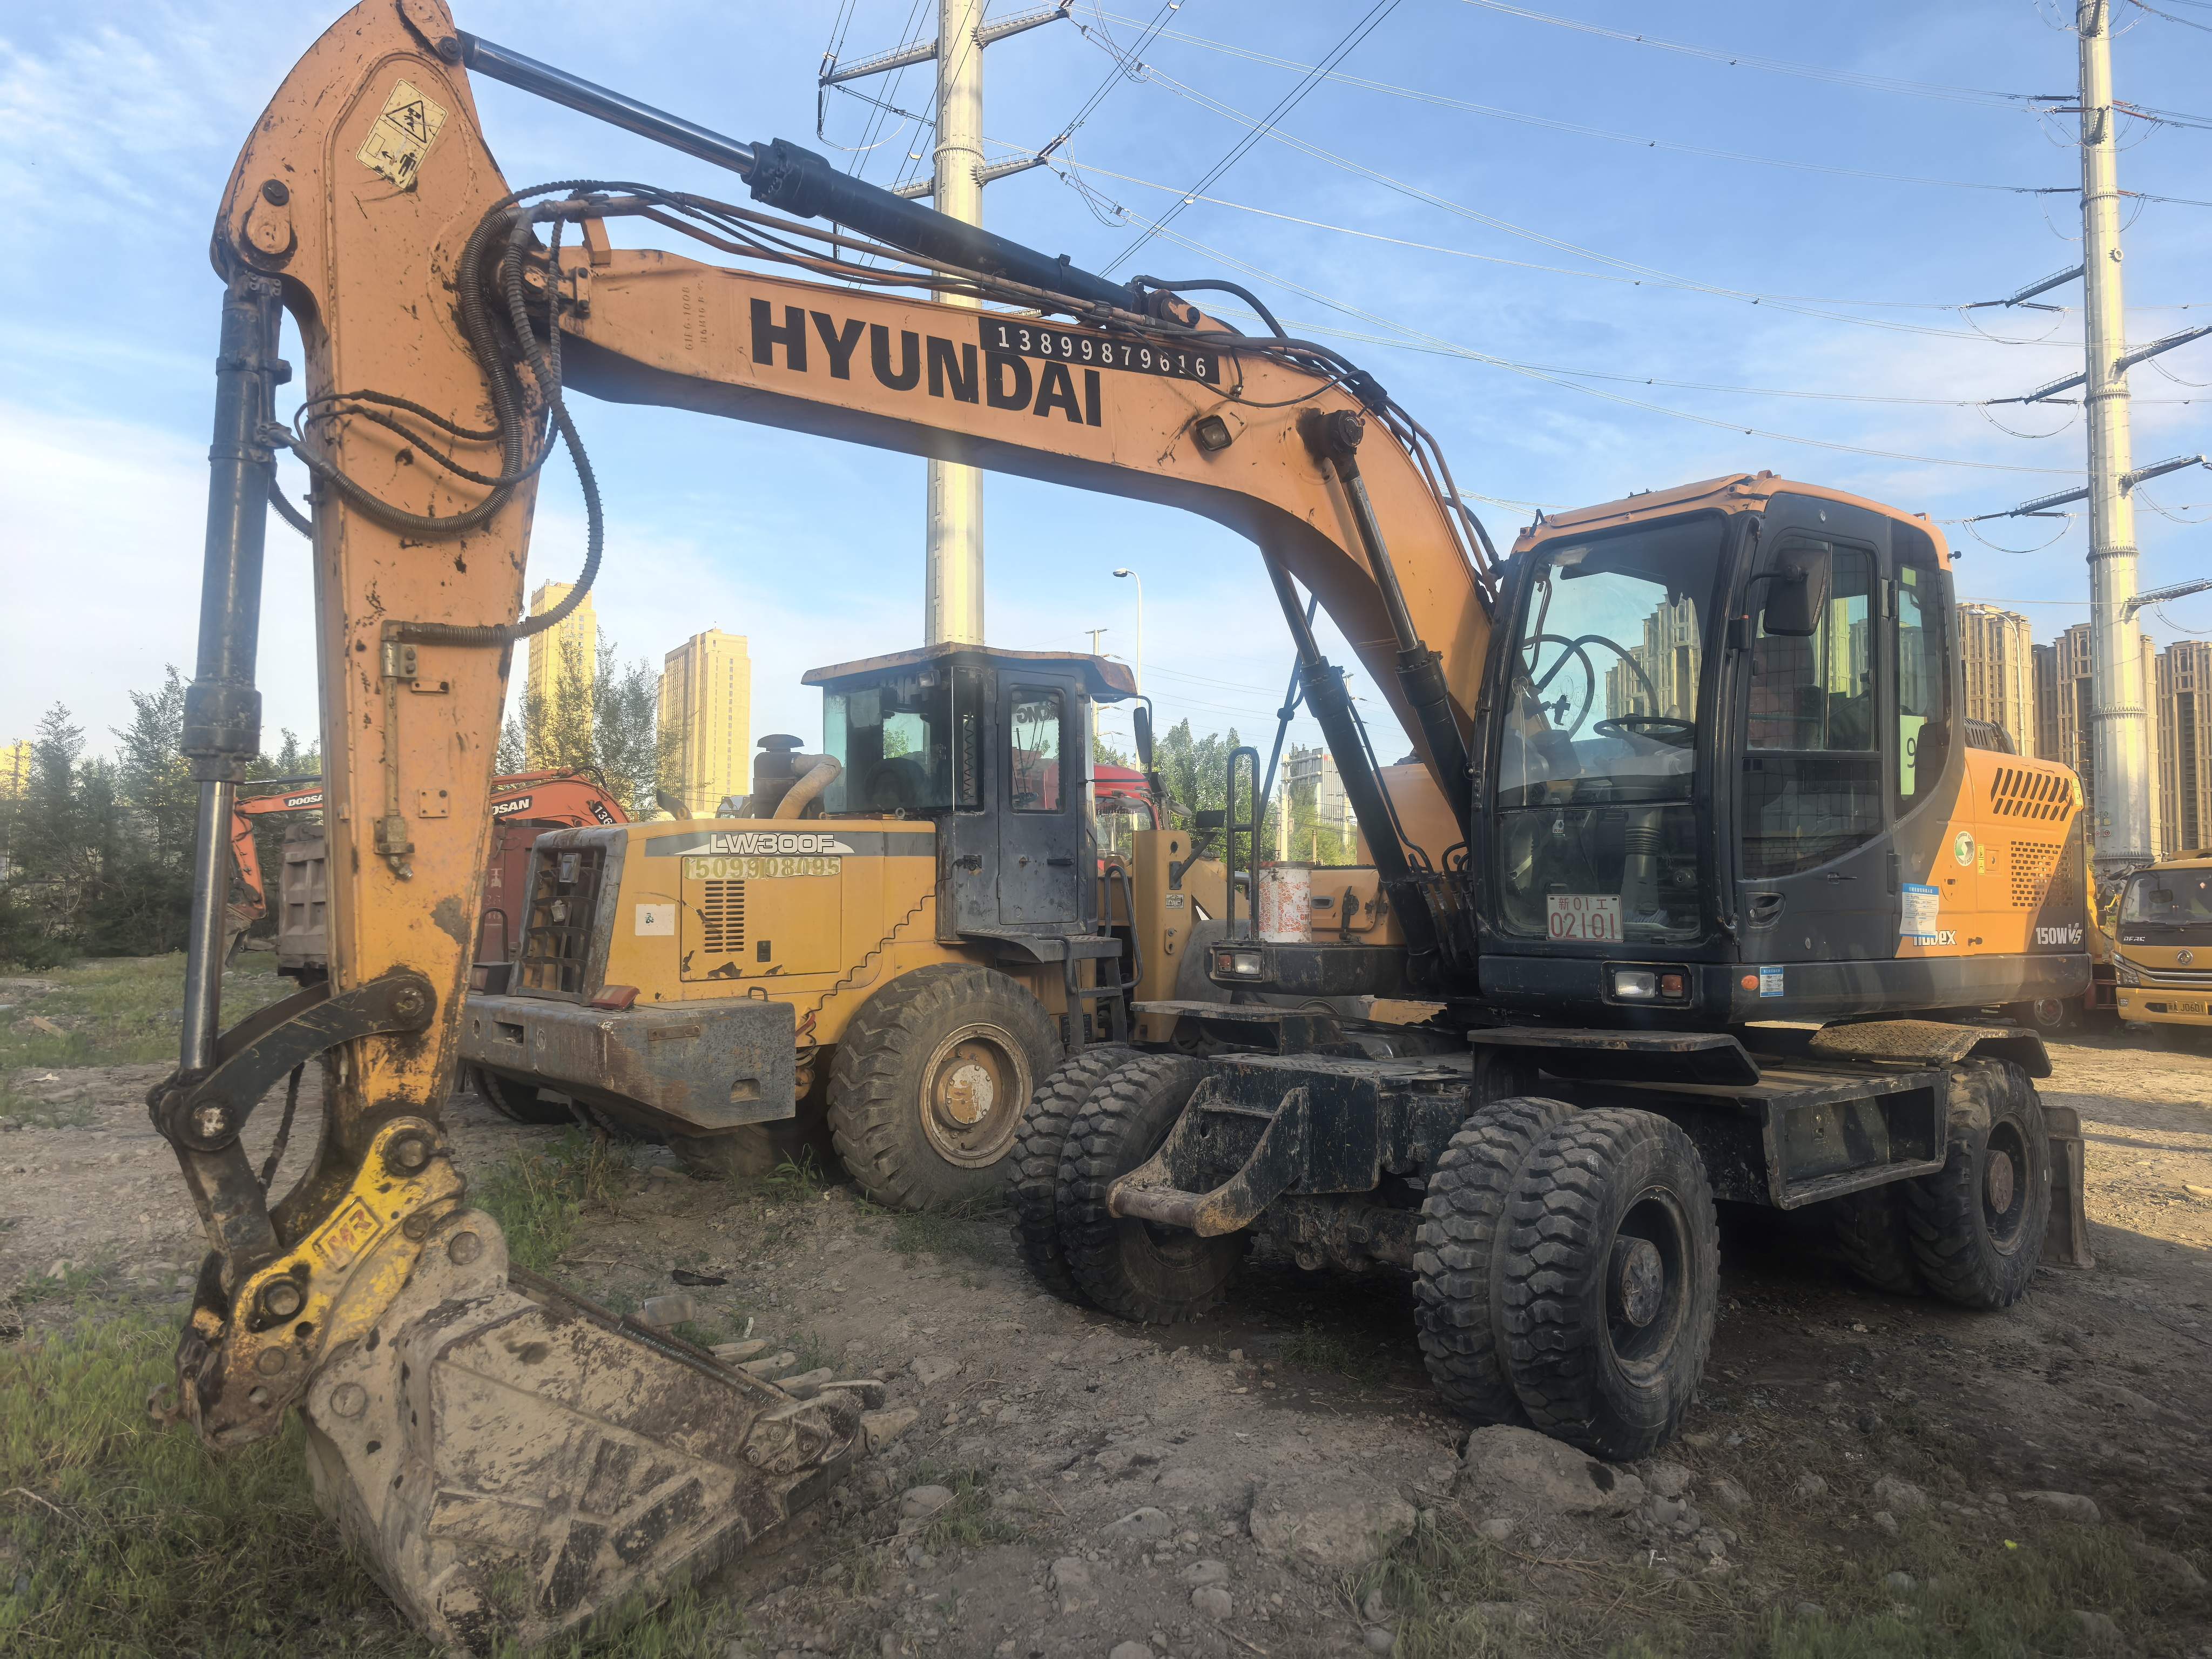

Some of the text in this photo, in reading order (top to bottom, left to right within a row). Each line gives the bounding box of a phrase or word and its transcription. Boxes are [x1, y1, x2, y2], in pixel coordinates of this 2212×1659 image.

[750, 297, 1102, 428] HYUNDAI
[997, 326, 1206, 377] 13899879616
[288, 794, 323, 806] DOOSA
[492, 799, 529, 815] OSAN
[710, 833, 835, 854] LW300F
[1550, 912, 1615, 939] 02101
